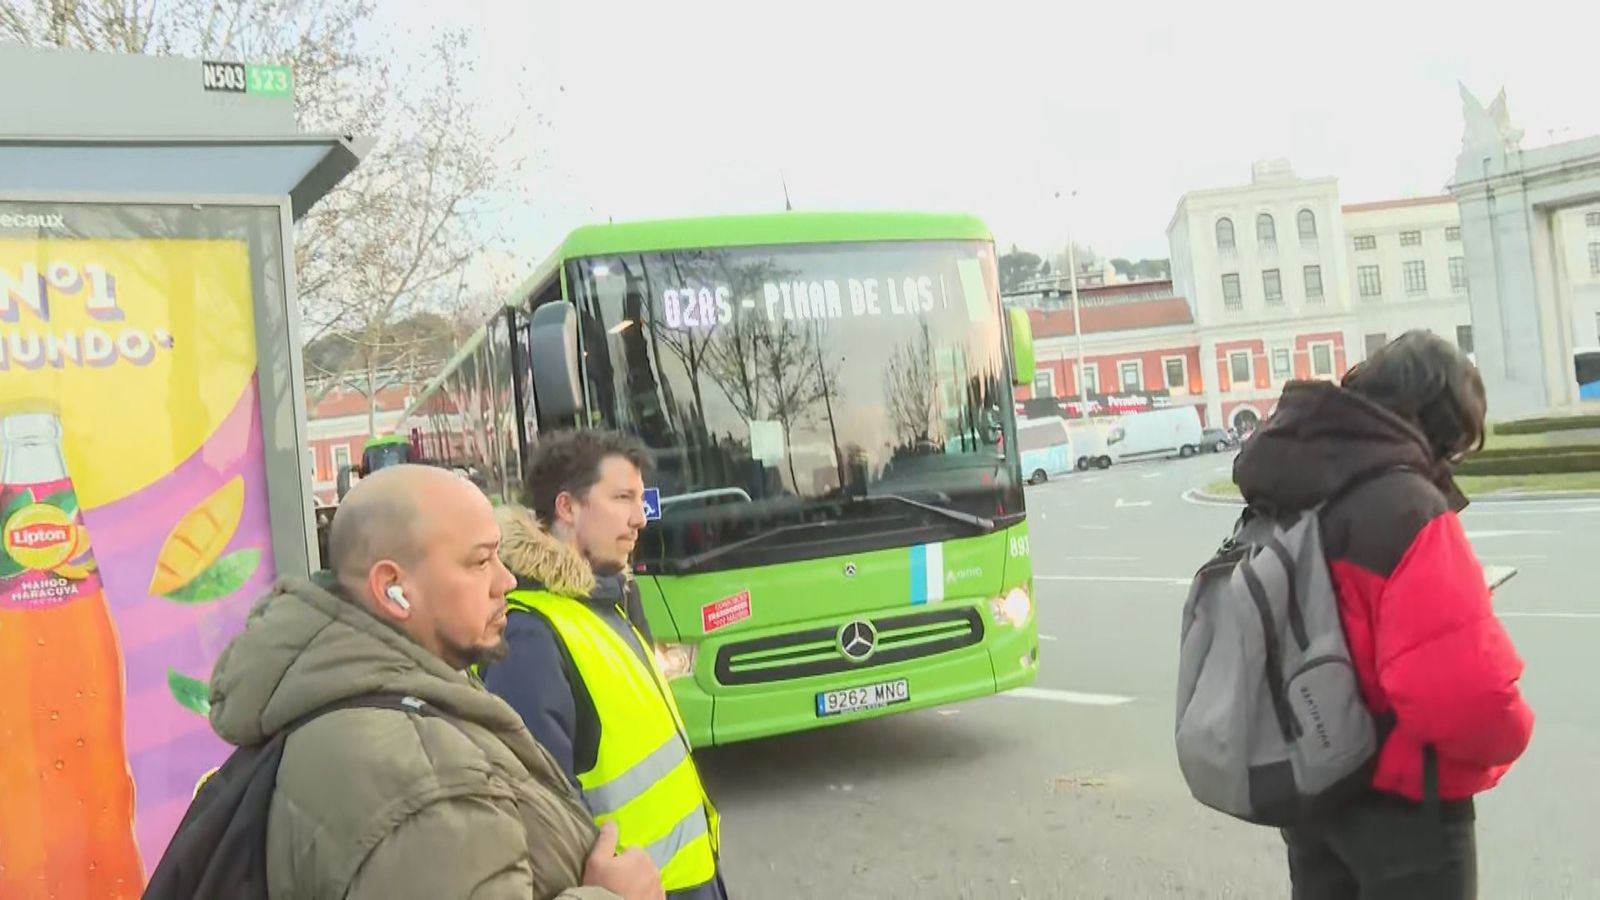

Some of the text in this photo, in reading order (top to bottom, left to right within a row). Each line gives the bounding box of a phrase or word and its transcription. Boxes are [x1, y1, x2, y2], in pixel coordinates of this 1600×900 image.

[203, 63, 246, 91] N503
[251, 67, 288, 92] 523
[849, 277, 881, 316] DE
[887, 275, 934, 315] LAS
[13, 528, 67, 546] Lipton
[828, 688, 867, 709] 9262
[875, 681, 905, 701] MNC
